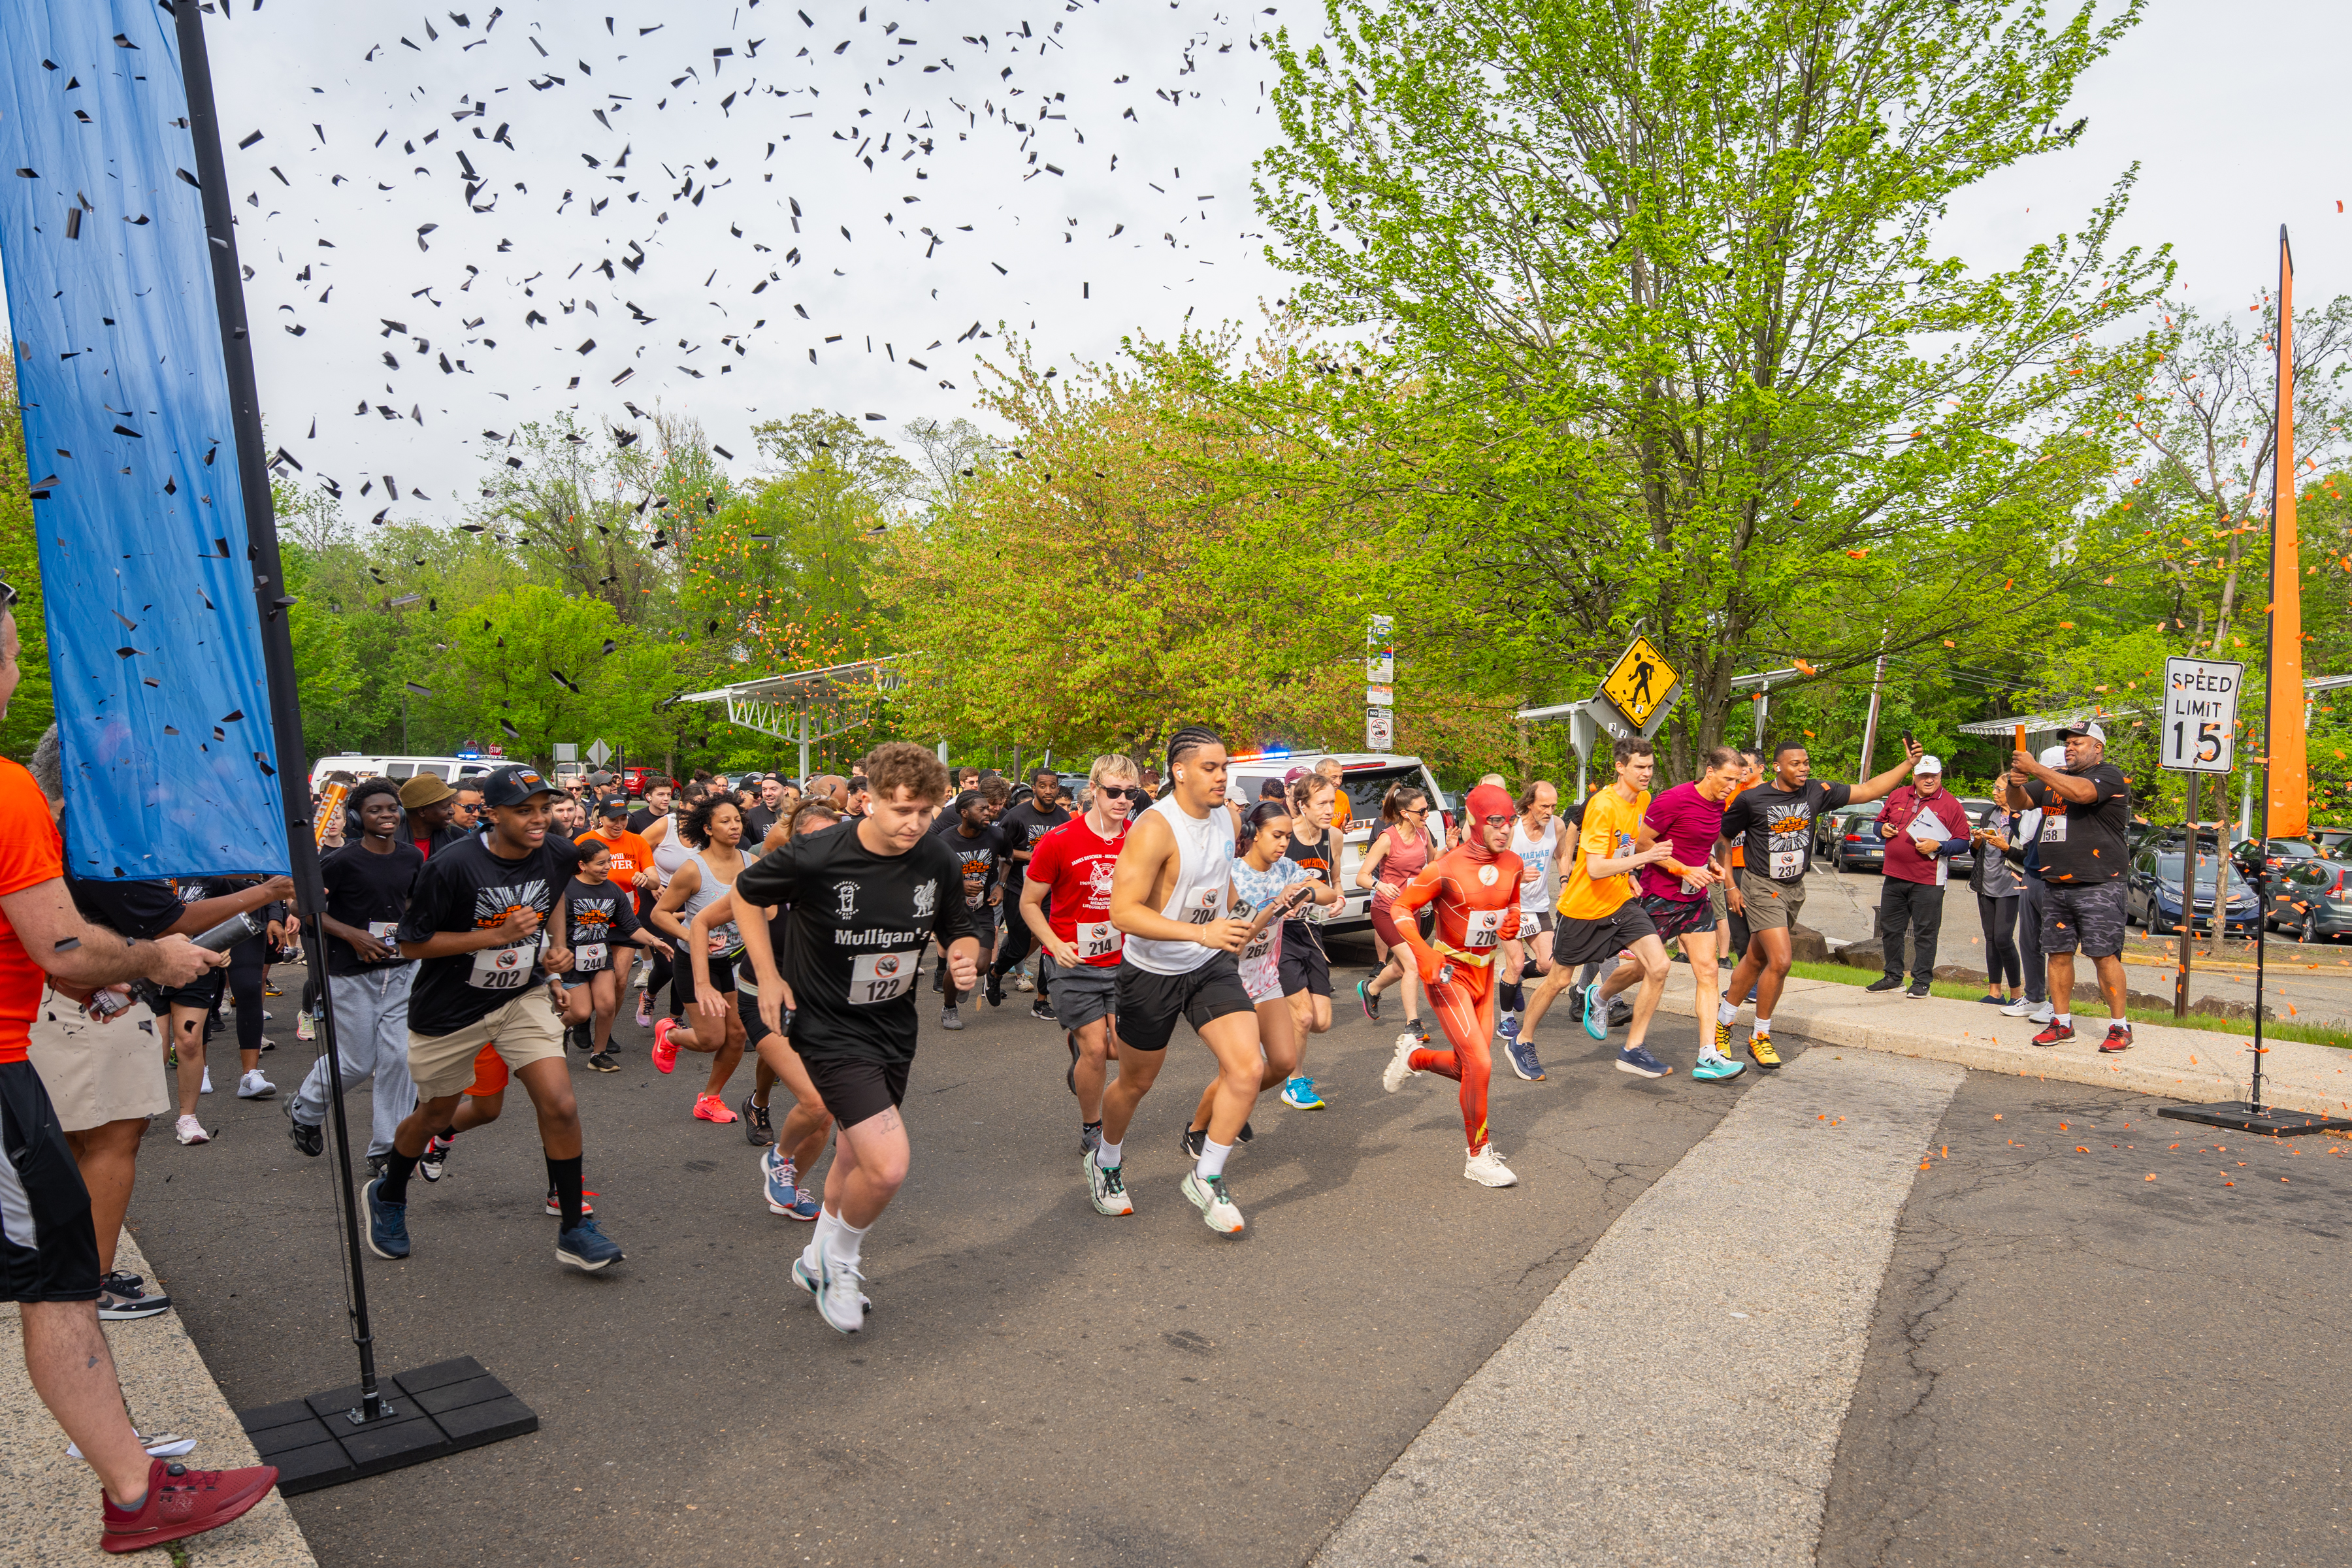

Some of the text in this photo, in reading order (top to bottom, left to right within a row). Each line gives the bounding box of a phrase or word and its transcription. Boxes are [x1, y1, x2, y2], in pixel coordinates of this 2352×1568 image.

[2172, 673, 2232, 693] SPEED
[2176, 699, 2221, 718] LIMIT
[2174, 721, 2221, 762] 15
[2042, 830, 2058, 841] 158
[1071, 857, 1085, 866] JAMES
[1519, 849, 1550, 860] MAHWAH
[1778, 864, 1797, 878] 237
[1189, 909, 1217, 925] 204
[834, 927, 930, 948] Mulligan's
[1475, 930, 1497, 945] 276
[1520, 924, 1536, 938] 208
[1088, 938, 1113, 956] 214
[1245, 942, 1269, 960] 262
[583, 958, 601, 971] 244
[482, 970, 521, 988] 202
[866, 978, 900, 1002] 122
